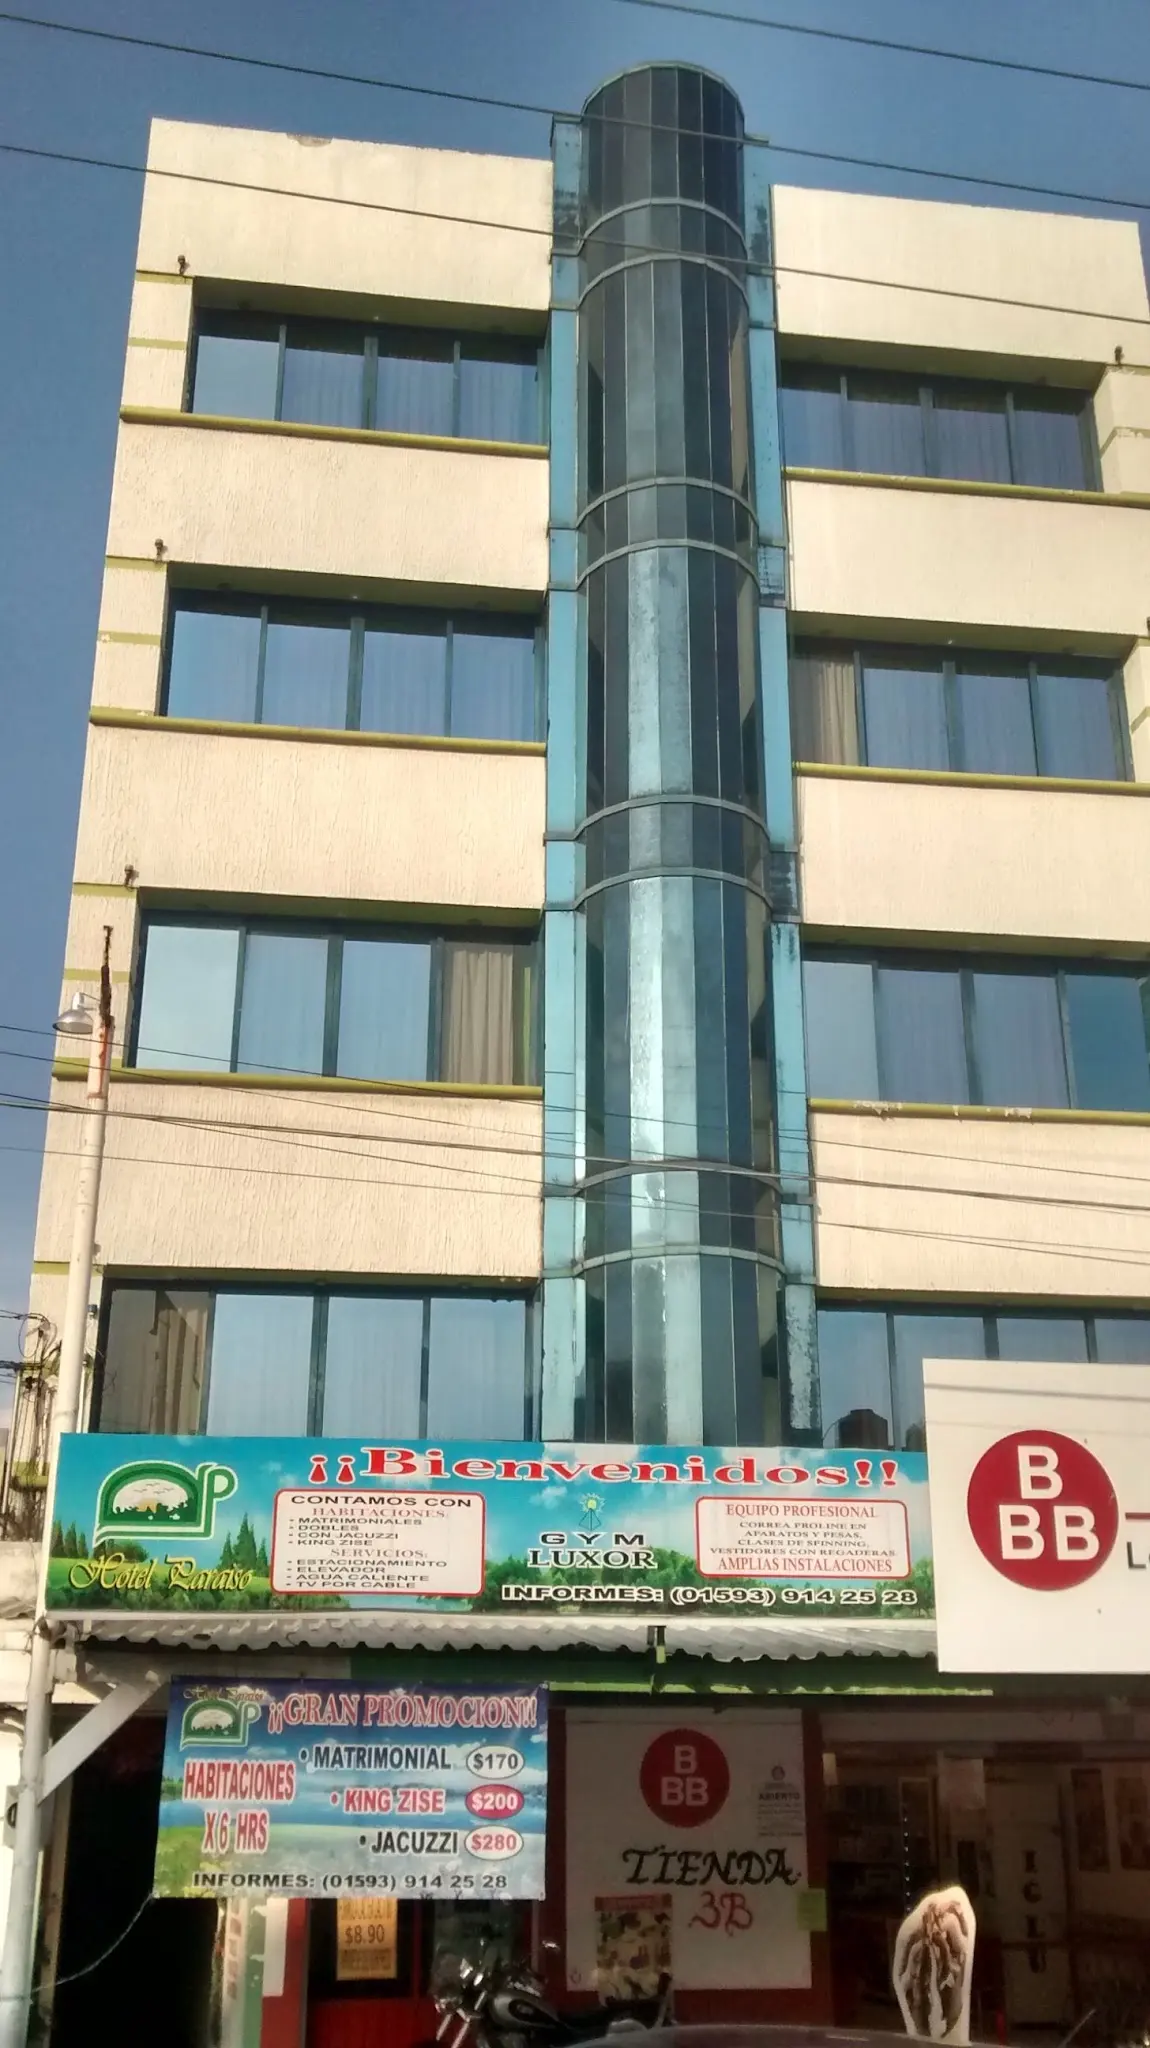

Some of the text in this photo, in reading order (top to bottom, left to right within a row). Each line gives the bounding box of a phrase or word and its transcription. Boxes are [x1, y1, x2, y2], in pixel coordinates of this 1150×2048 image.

[1018, 1445, 1063, 1499] B
[291, 1495, 471, 1507] CONTAMOS CON
[726, 1504, 878, 1518] EQUIPO PROFESIONAL
[299, 1517, 422, 1525] MATRIMONIALES
[739, 1521, 790, 1529] CORREA
[795, 1522, 846, 1530] PROLINE
[335, 1532, 399, 1540] JACUZZI
[744, 1530, 808, 1538] APARATOS
[999, 1504, 1100, 1561] BB
[530, 1551, 656, 1568] LUXOR
[790, 1548, 817, 1556] CON
[1127, 1541, 1150, 1570] L
[70, 1552, 157, 1590] Hotel
[297, 1559, 447, 1567] ESTACIONAMIENTO
[719, 1557, 893, 1573] AMPLIAS INSTALACIONES
[503, 1586, 917, 1606] INFORMES: (01593) 914 25 28
[313, 1747, 519, 1770] MATRIMONIAL $170
[675, 1745, 697, 1773] B
[184, 1763, 295, 1800] HABITACIONES
[661, 1776, 709, 1806] BB
[343, 1790, 519, 1813] KING ZISE $200
[219, 1815, 230, 1850] 6
[236, 1813, 268, 1853] HRS
[371, 1832, 518, 1854] JACUZZI $280
[194, 1873, 508, 1892] INFORMES: (01593) 914 25 28
[344, 1923, 386, 1946] $8.90
